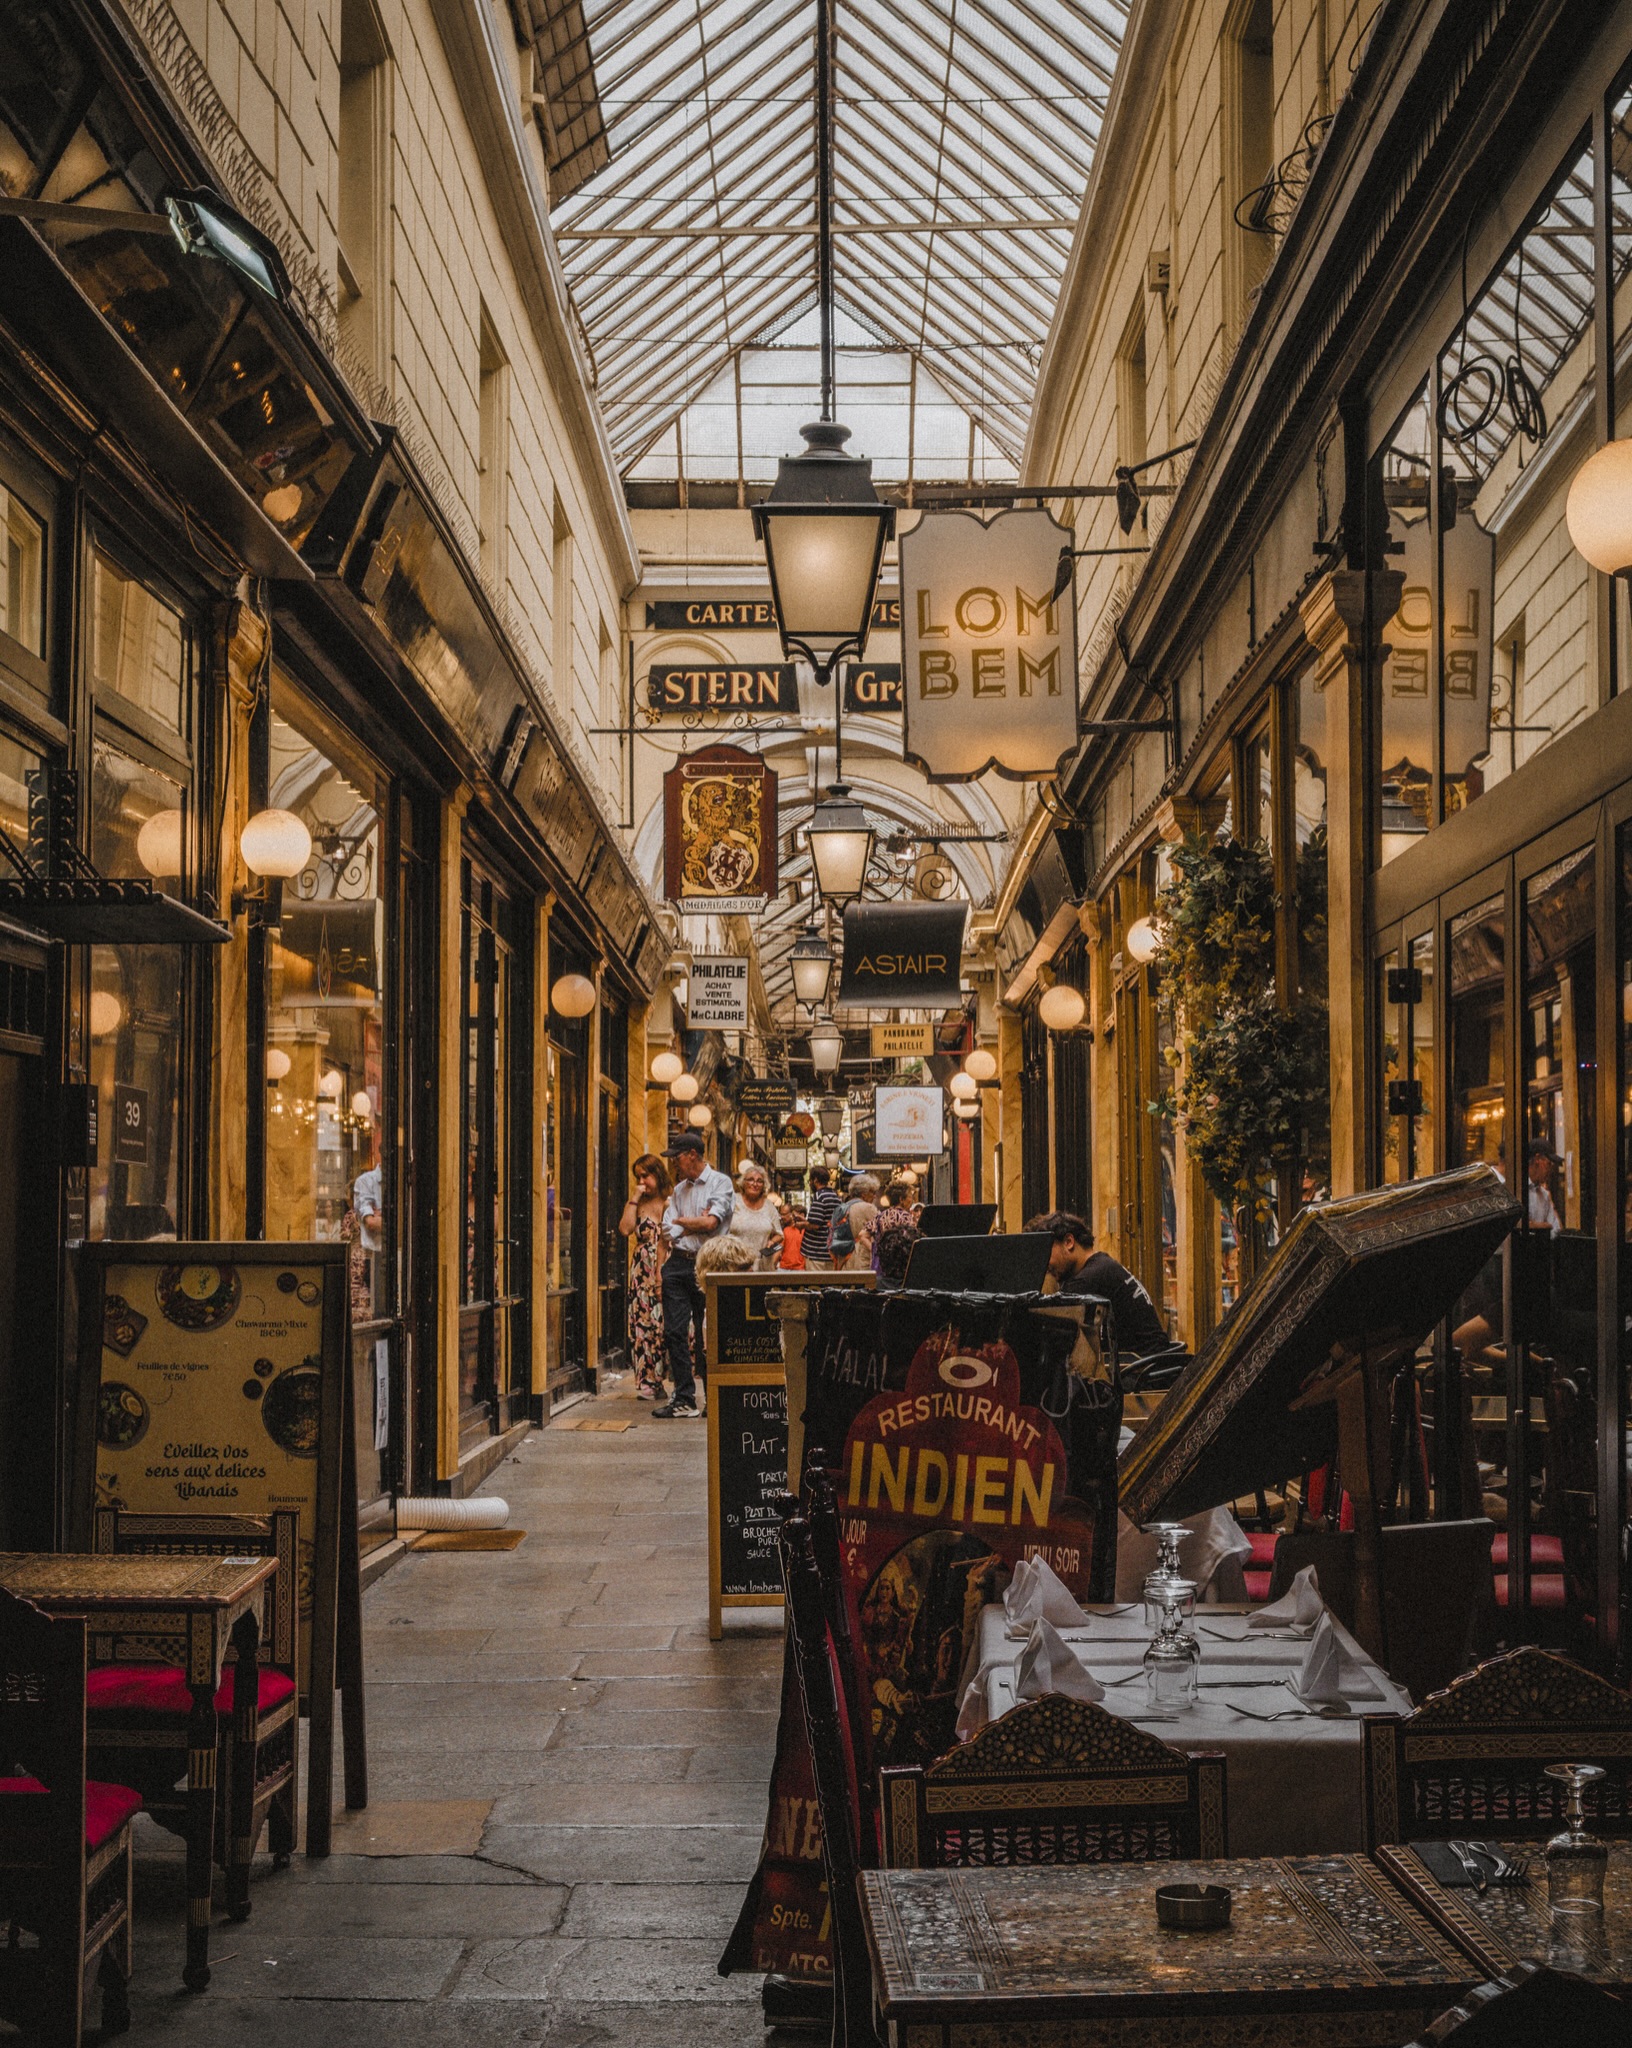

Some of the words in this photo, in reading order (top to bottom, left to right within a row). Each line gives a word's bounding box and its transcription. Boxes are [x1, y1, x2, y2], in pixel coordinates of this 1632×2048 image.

[917, 586, 1060, 639] LOM
[918, 645, 1062, 701] BEM
[664, 671, 780, 704] STERN
[740, 900, 763, 910] D'OR
[855, 954, 947, 975] ASTAIR
[705, 982, 732, 990] ACHAT
[695, 999, 741, 1007] ESTIMATION
[883, 1029, 924, 1038] PANORAMAS
[883, 1042, 924, 1051] PHILATELIE
[125, 1100, 140, 1128] 39
[235, 1320, 282, 1328] Chawarma
[284, 1320, 308, 1328] Mixte
[727, 1337, 752, 1346] SALLE
[756, 1337, 775, 1346] COSY
[137, 1362, 168, 1370] Feuilles
[170, 1362, 180, 1370] de
[182, 1362, 209, 1372] vignes
[820, 1335, 893, 1393] HALAL
[162, 1373, 186, 1381] 7€50
[878, 1392, 1041, 1450] RESTAURANT
[742, 1431, 779, 1455] PLAT
[164, 1443, 219, 1460] Eveillez
[223, 1444, 249, 1458] vos
[145, 1466, 179, 1477] sens
[184, 1464, 211, 1479] aux
[215, 1463, 267, 1478] delices
[757, 1471, 787, 1484] TARTA
[174, 1481, 239, 1500] Libanais
[847, 1440, 1055, 1528] INDIEN
[268, 1495, 308, 1503] Houmous
[744, 1506, 765, 1518] PLAT
[846, 1518, 867, 1544] JOUR
[746, 1548, 771, 1559] SAUCE
[1055, 1546, 1080, 1573] SOIR
[770, 1903, 813, 1932] Spte.
